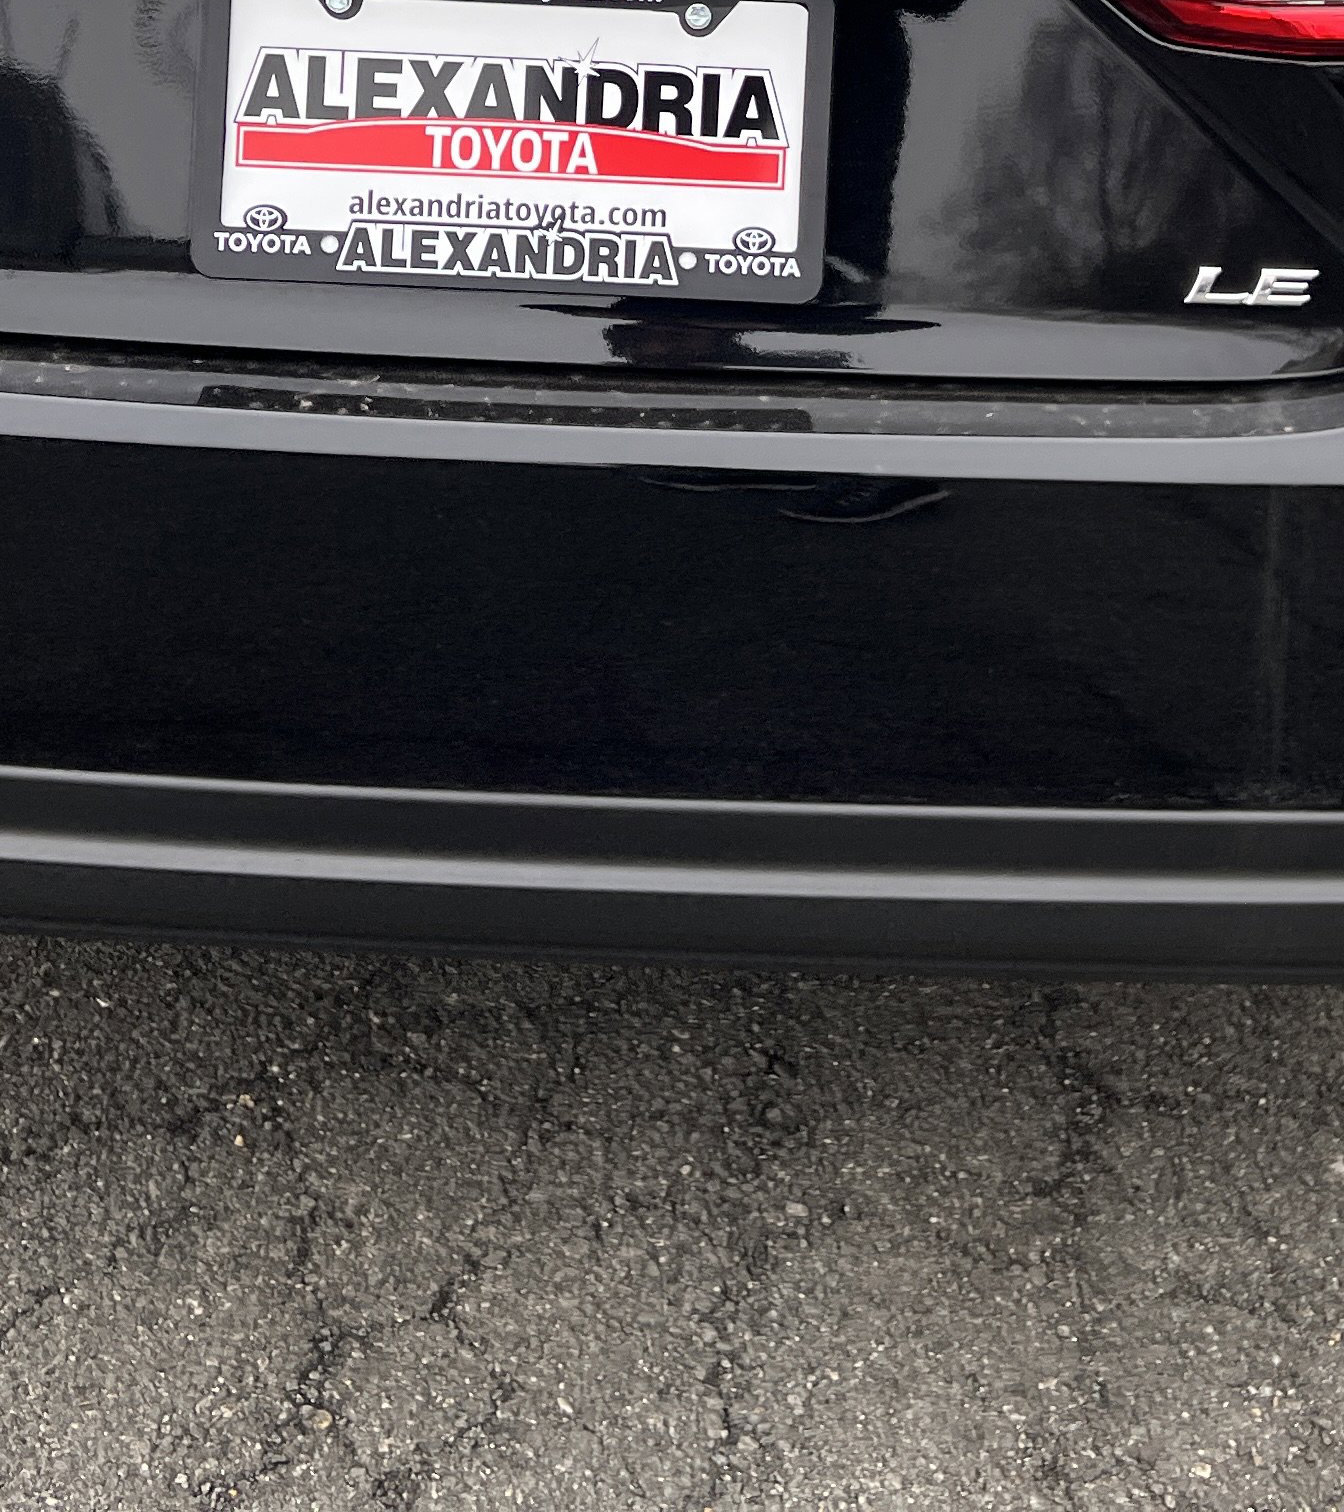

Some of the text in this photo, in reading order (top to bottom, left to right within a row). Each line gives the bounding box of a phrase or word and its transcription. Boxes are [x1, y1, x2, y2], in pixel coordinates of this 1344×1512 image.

[241, 49, 782, 142] ALEXANDRIA
[425, 125, 598, 175] TOYOTA
[348, 189, 667, 228] alexandriatoyota.com
[213, 230, 312, 256] TOYOTA
[338, 223, 678, 284] ALEXANDRIA
[704, 253, 802, 278] TOYOTA
[1183, 266, 1320, 306] LE
